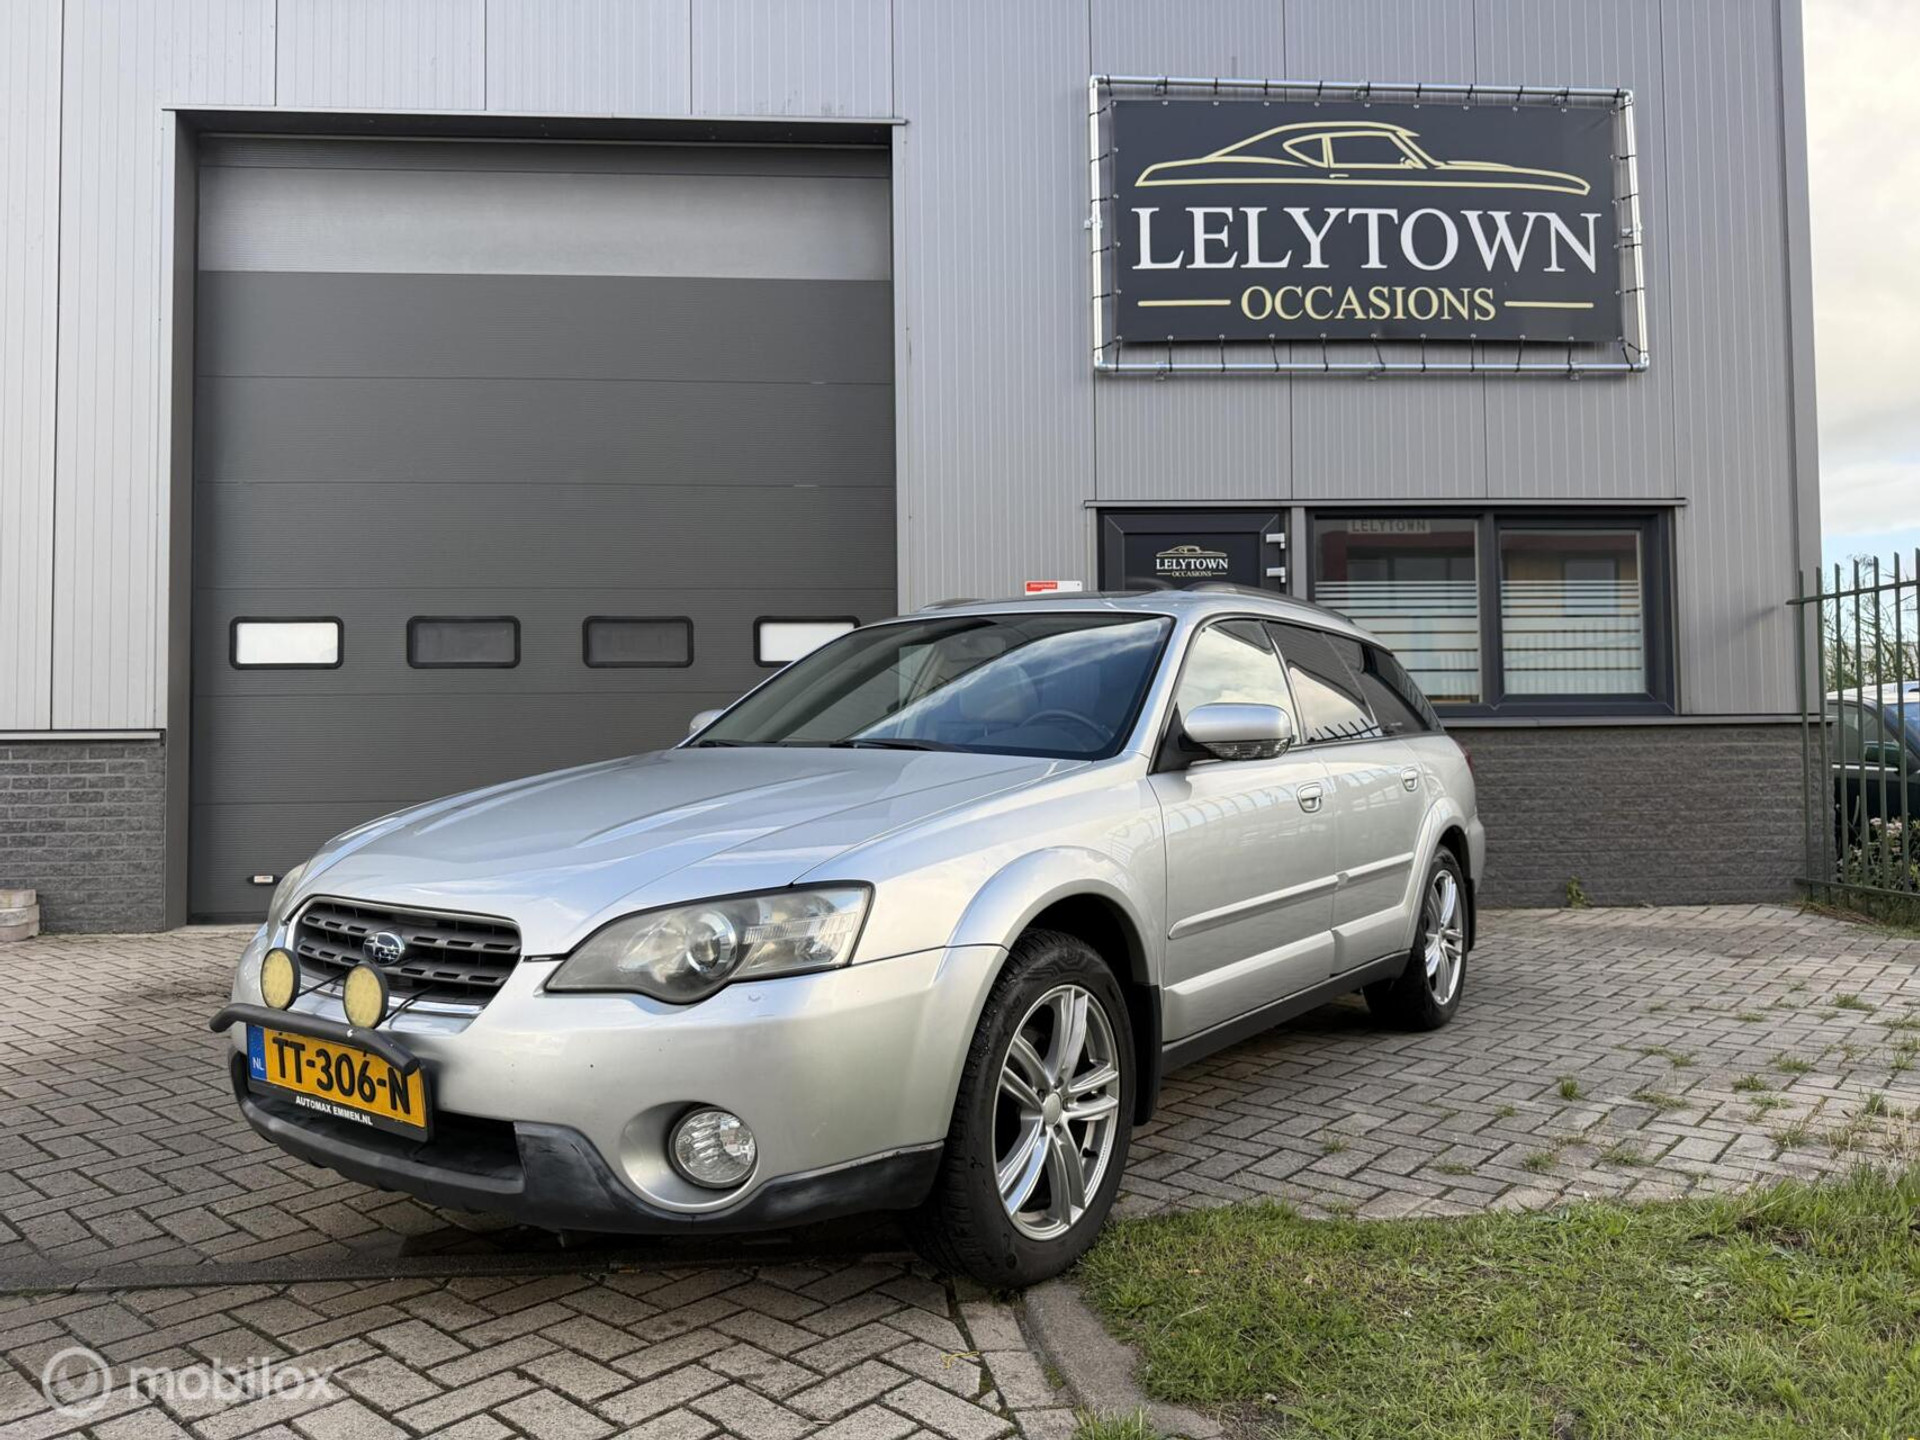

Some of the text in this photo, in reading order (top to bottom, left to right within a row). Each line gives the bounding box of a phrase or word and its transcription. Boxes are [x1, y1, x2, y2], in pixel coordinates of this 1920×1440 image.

[1130, 206, 1602, 274] LELYTOWN
[1240, 284, 1497, 322] OCCASIONS
[1351, 520, 1426, 533] LELYTOWN
[1156, 558, 1228, 570] LELYTOWN
[252, 1056, 264, 1071] NL
[272, 1037, 411, 1115] TT-306-N
[295, 1095, 374, 1126] AUTOMAX EMMEN.NL
